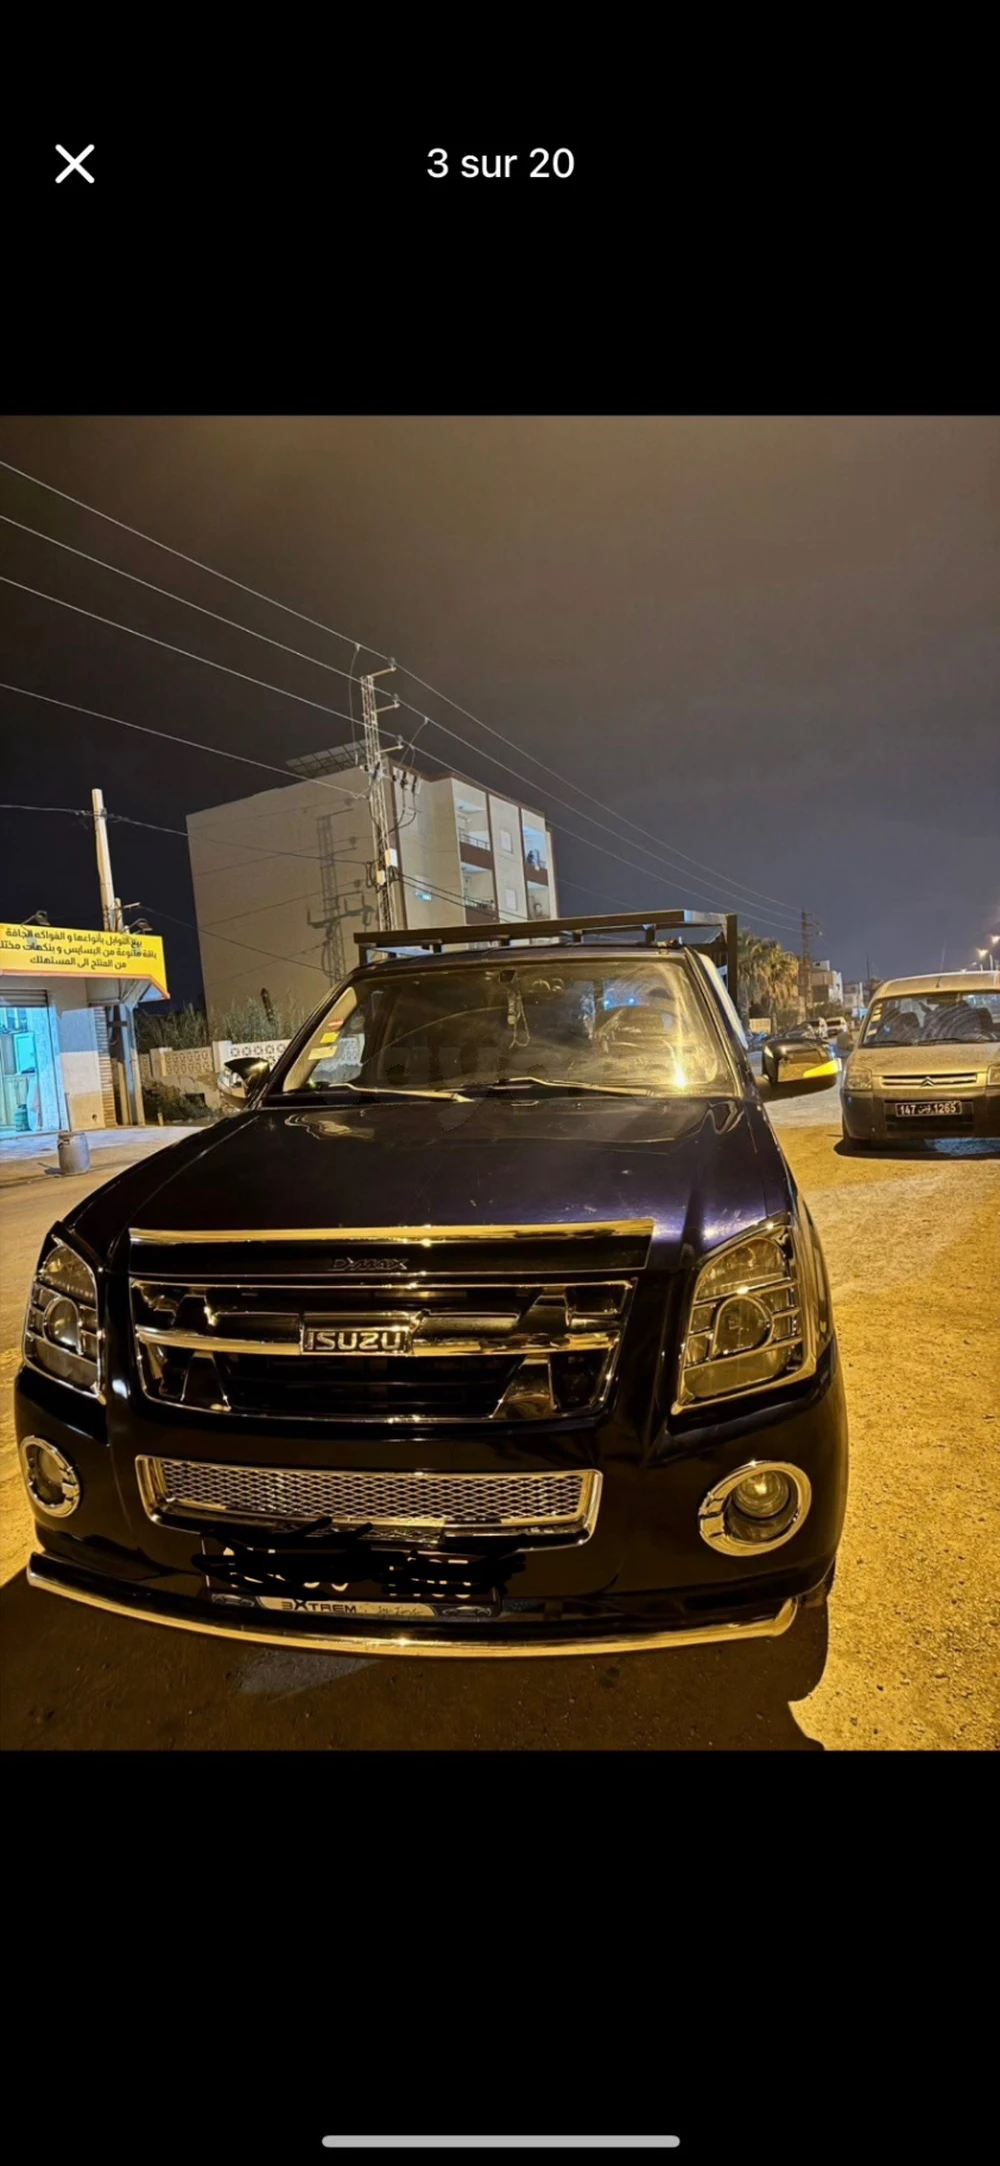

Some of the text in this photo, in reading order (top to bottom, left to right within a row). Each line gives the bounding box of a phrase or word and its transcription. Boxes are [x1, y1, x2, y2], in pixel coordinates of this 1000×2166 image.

[5, 927, 34, 939] الجافة
[67, 934, 73, 943] و
[56, 945, 62, 954] و
[102, 949, 115, 958] من
[116, 947, 142, 959] متنوعة
[29, 955, 76, 965] المستهلك
[91, 958, 114, 970] المنتج
[114, 961, 127, 970] من
[900, 1104, 916, 1115] 147
[304, 1331, 402, 1351] ISUZU
